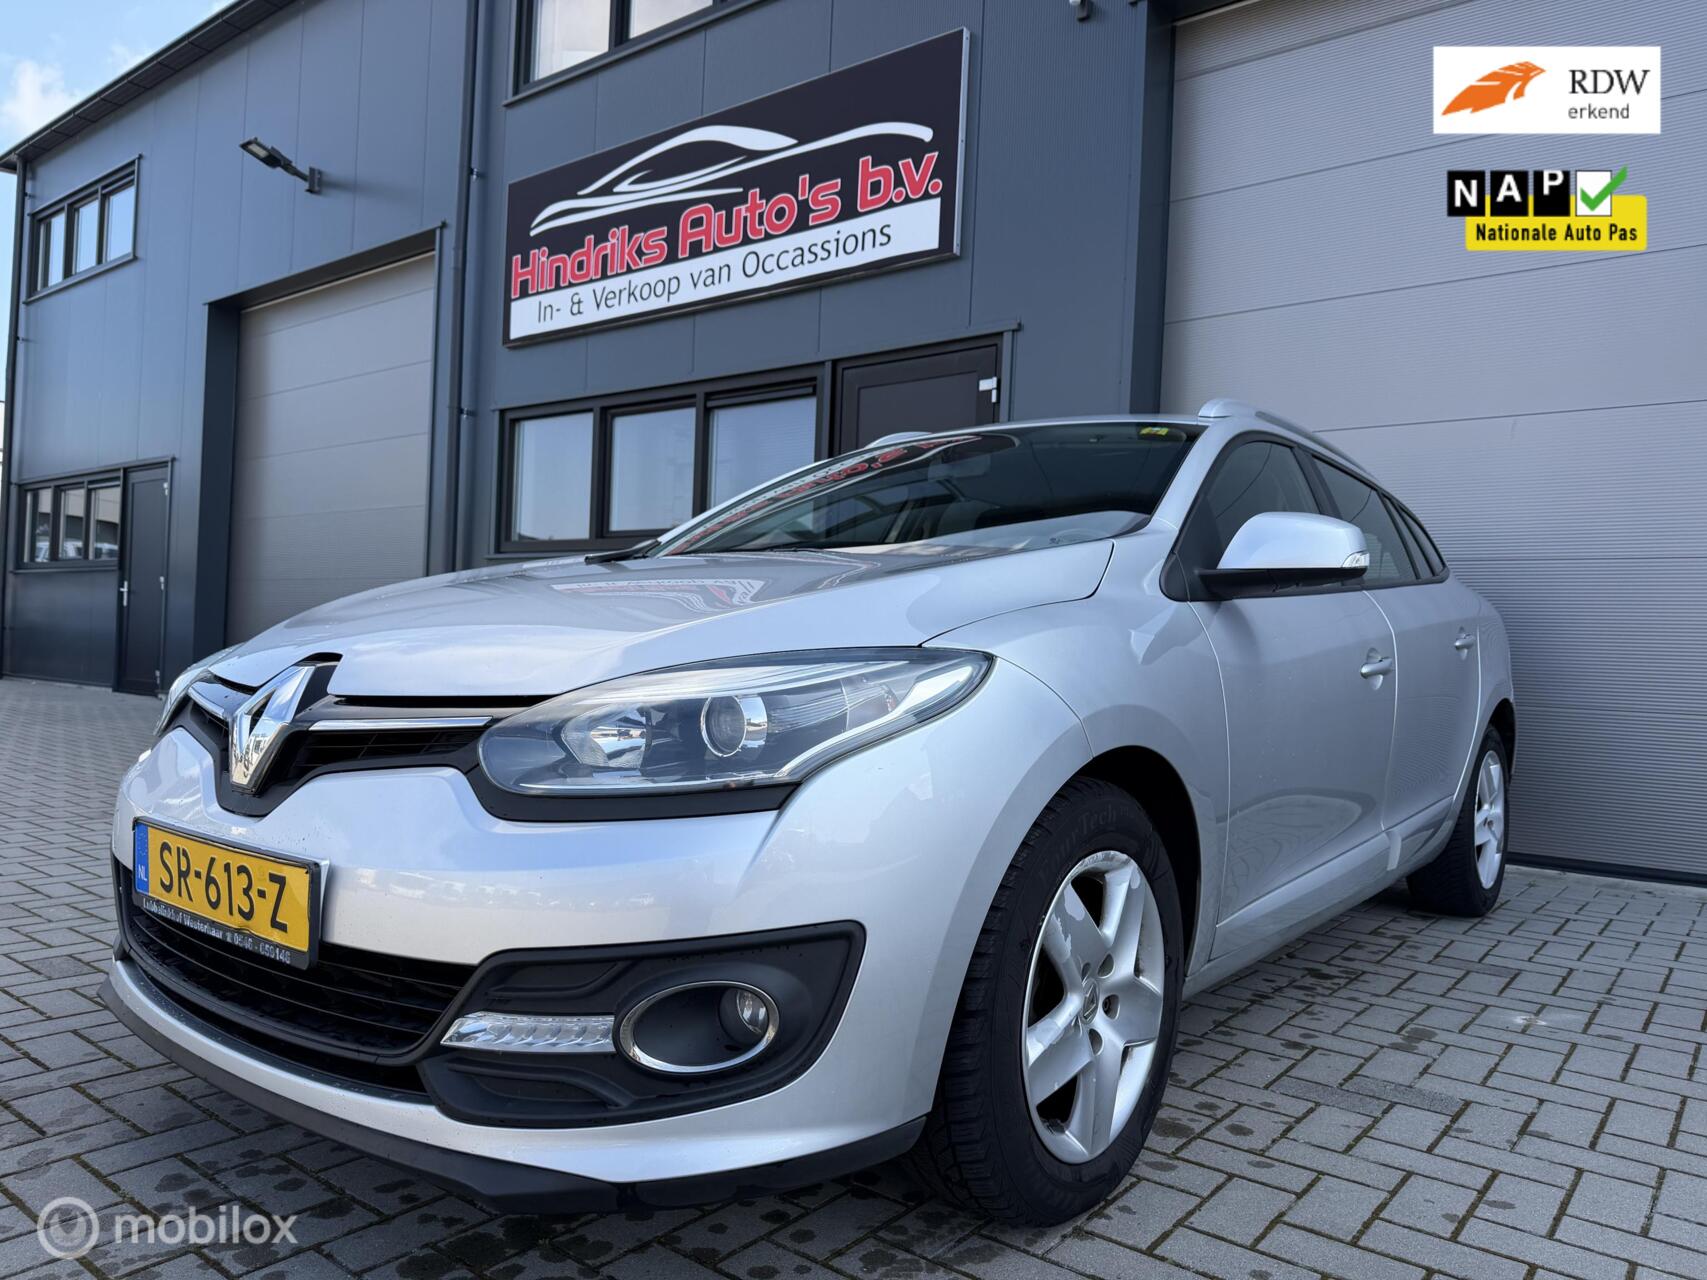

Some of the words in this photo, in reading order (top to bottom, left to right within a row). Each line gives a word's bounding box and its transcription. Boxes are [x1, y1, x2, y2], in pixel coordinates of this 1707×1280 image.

[510, 226, 668, 298] Hindriks
[678, 174, 841, 258] Auto's
[857, 152, 943, 213] b.v.
[537, 293, 561, 323] In-
[569, 292, 584, 315] &
[592, 274, 681, 312] Verkoop
[690, 264, 731, 291] van
[741, 223, 892, 278] Occassions
[138, 863, 148, 882] NL
[159, 841, 288, 933] SR-613-Z
